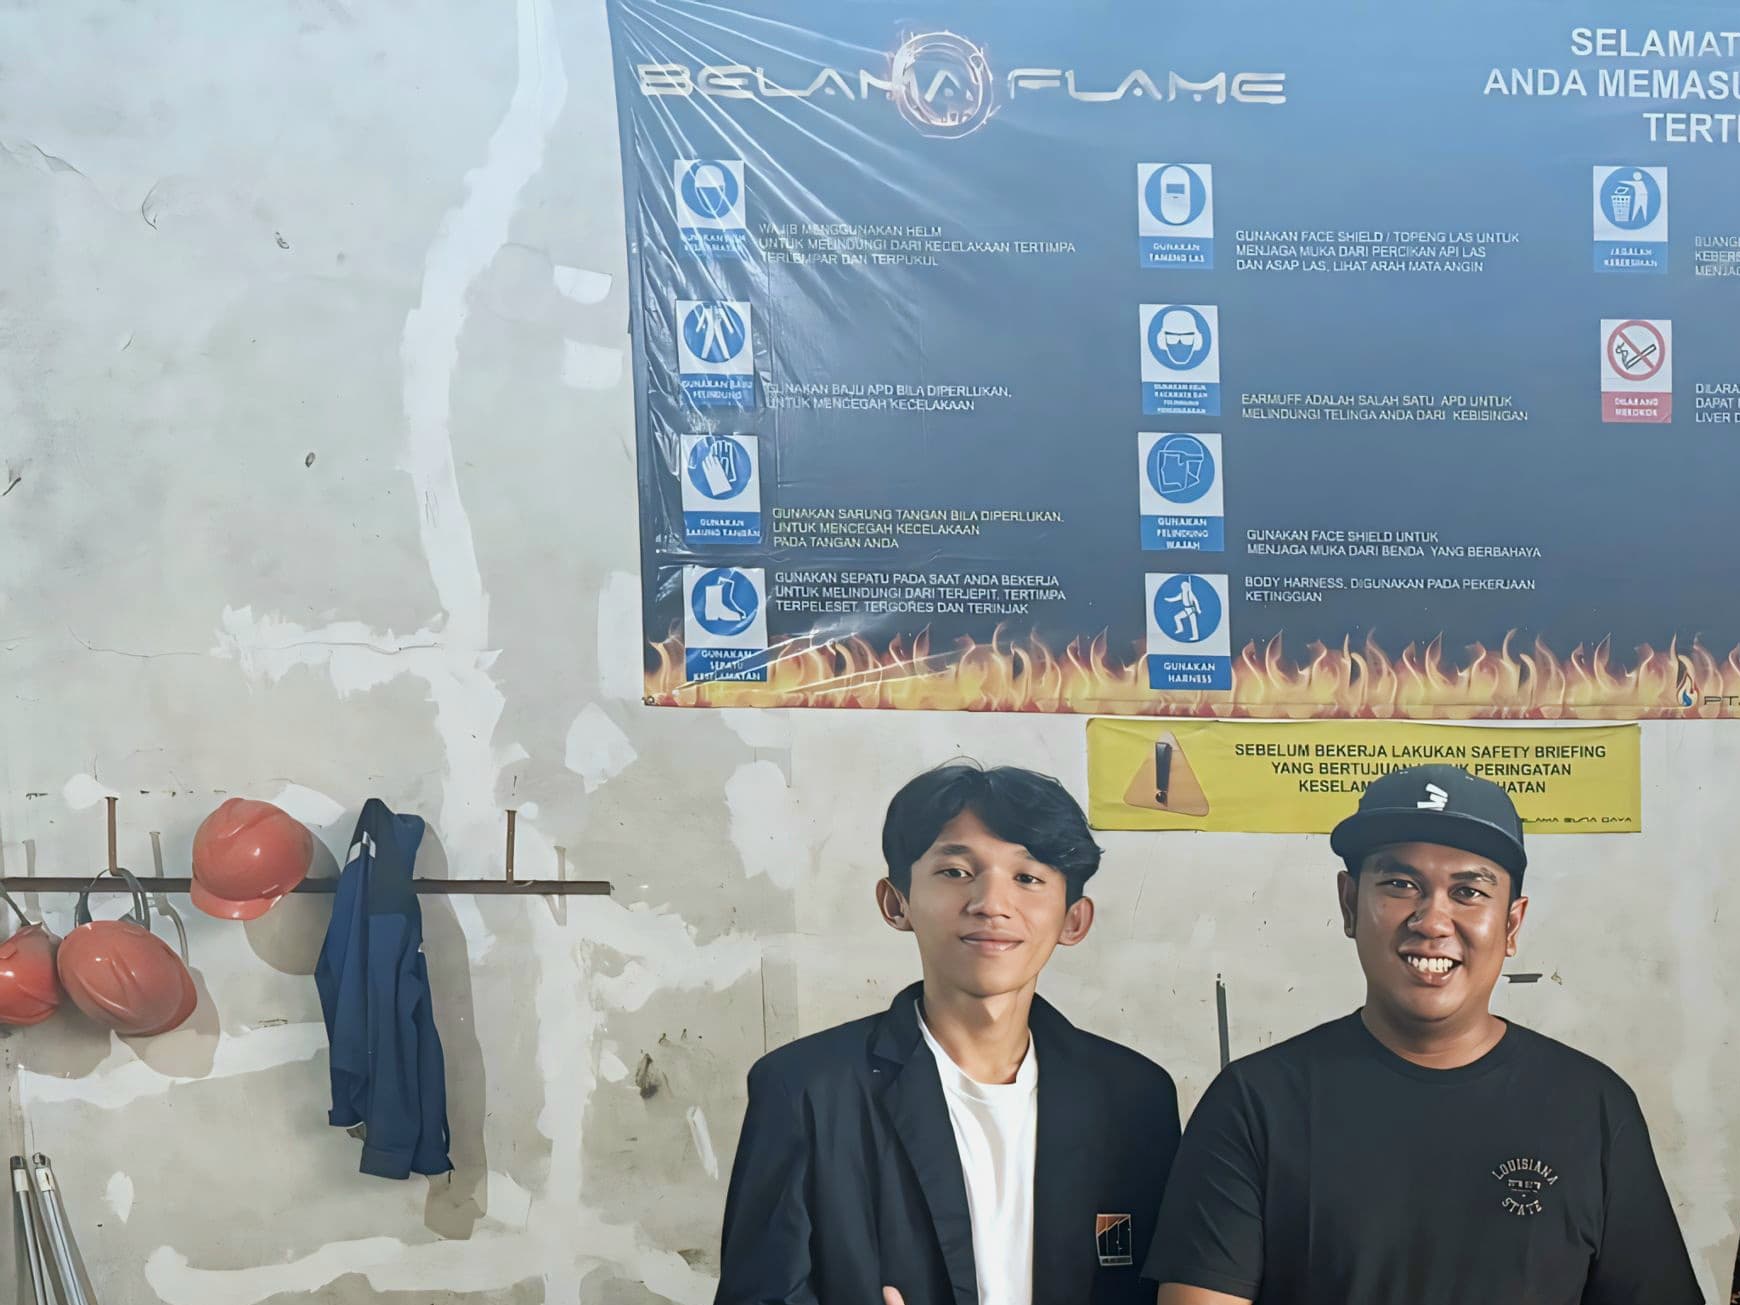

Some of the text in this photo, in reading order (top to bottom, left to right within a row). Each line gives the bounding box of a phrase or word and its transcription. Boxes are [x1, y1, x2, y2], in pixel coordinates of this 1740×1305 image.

[1008, 69, 1286, 104] FLAME
[1484, 67, 1588, 97] ANDA
[906, 225, 942, 238] HELM
[1235, 230, 1298, 242] GUNAKAN
[1300, 231, 1334, 243] FACE
[1337, 231, 1383, 243] SHIELD
[1392, 232, 1446, 243] TOPENG
[1449, 232, 1474, 244] LAS
[1476, 232, 1520, 244] UNTUK
[758, 238, 804, 249] UNTUK
[807, 239, 888, 250] MELINDUNGI
[890, 239, 922, 251] DARI
[925, 240, 1010, 252] KECELAKAAN
[1013, 241, 1076, 252] TERTIMPA
[1236, 244, 1487, 258] MENJAGA MUKA DARI PERCIKAN API LAS
[841, 254, 867, 265] DAN
[871, 254, 939, 266] TERPUKUL
[1236, 260, 1484, 272] DAN ASAP LIHAT ARAH MATA ANGIN
[831, 385, 866, 396] BAJU
[867, 385, 894, 396] APD
[896, 385, 925, 397] BILA
[767, 398, 975, 410] UNTUK MENCEGAH KECELAKAAN
[1241, 394, 1512, 407] EARMUFF ADALAH SALAH SATU APD UNTUK
[1695, 398, 1734, 409] DAPAT
[1241, 408, 1528, 421] MELINDUNGI TELINGA ANDA DARI KEBISINGAN
[1695, 412, 1730, 423] LIVER
[772, 508, 978, 521] GUNAKAN SARUNG TANGAN BILA
[772, 522, 980, 535] UNTUK MENCEGAH KECELAKAAN
[1246, 529, 1439, 542] GUNAKAN FACE SHIELD UNTUK
[773, 536, 899, 549] PADA TANGAN ANDA
[1246, 544, 1542, 557] MENJAGA MUKA DARI BENDA YANG BERBAHAYA
[775, 572, 1060, 586] GUNAKAN SEPATU PADA SAAT ANDA BEKERJA
[1245, 576, 1536, 590] BODY DIGUNAKAN PADA PEKERJAAN
[776, 586, 1067, 600] UNTUK MELINDUNGI DARI TERTIMPA
[1245, 590, 1322, 602] KETINGGIAN
[863, 601, 1029, 614] TERGORES DAN TERINJAK
[1234, 744, 1608, 759] SEBELUM BEKERJA LAKUKAN SAFETY BRIEFING
[1271, 762, 1314, 775] YANG
[1475, 763, 1572, 776] PERINGATAN
[1491, 1158, 1559, 1185] LOUISIANA
[1501, 1197, 1543, 1216] STATE
